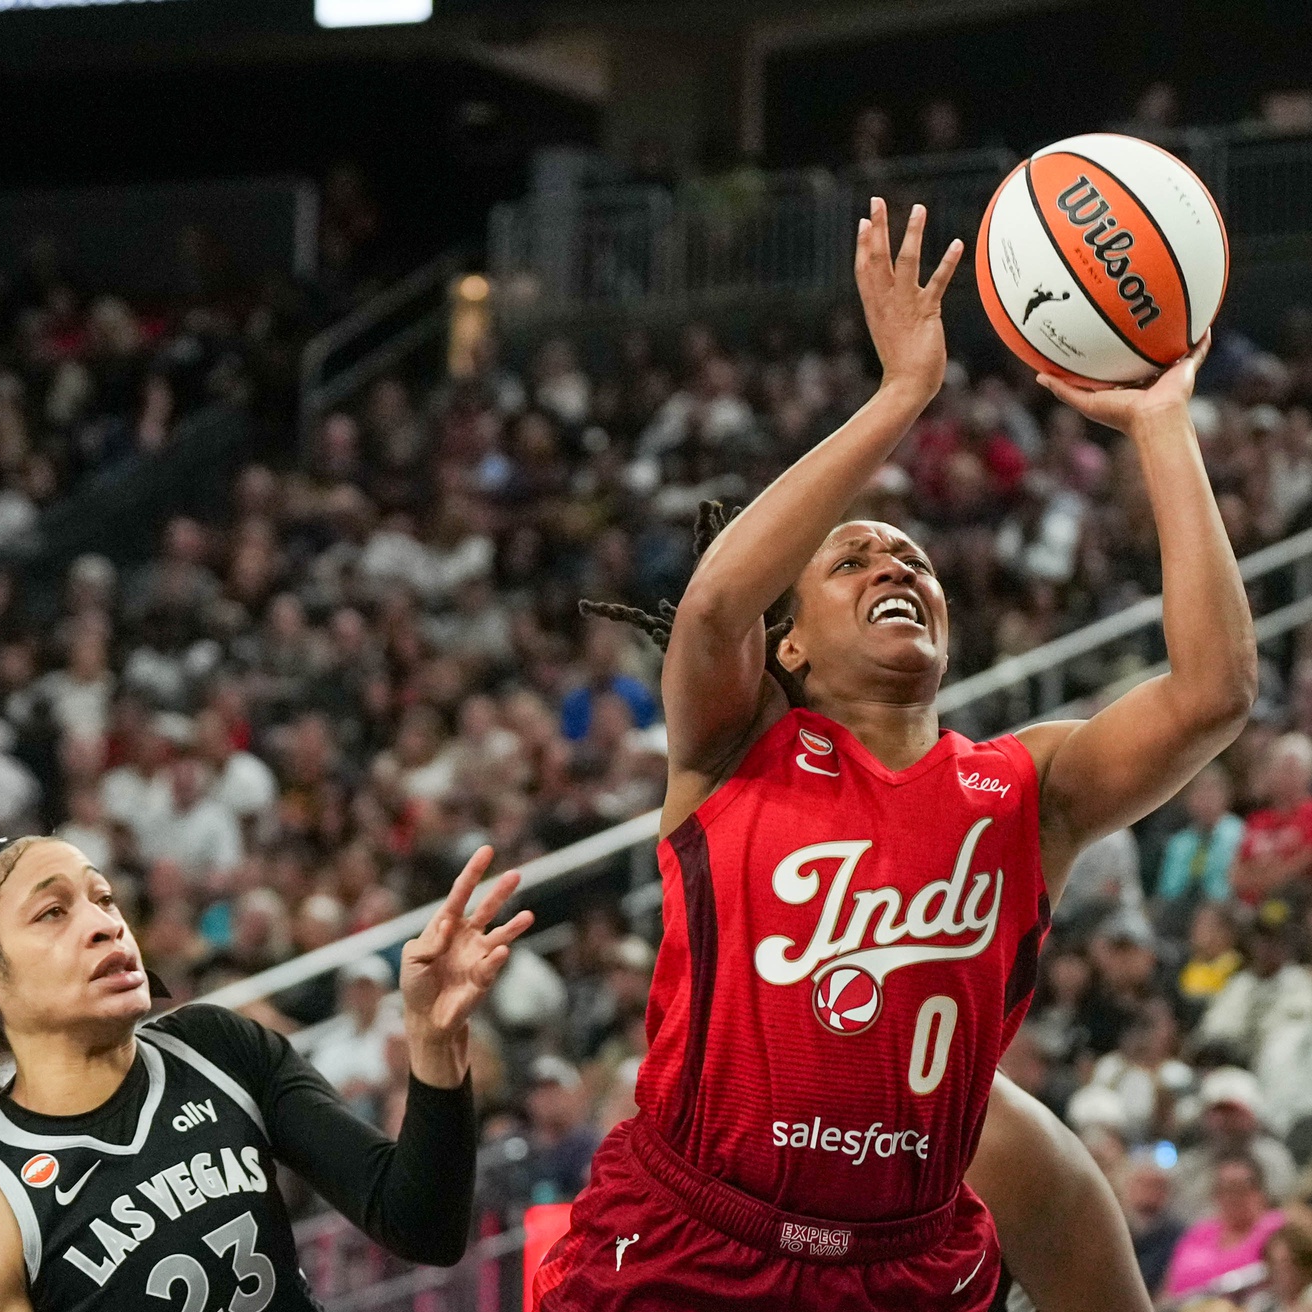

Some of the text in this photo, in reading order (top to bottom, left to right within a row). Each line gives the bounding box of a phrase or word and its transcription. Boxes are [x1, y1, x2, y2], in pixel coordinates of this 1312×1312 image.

[1056, 173, 1162, 332] Wilson
[957, 771, 1012, 799] Lilly
[754, 816, 1003, 986] Indy
[908, 995, 958, 1095] 0
[171, 1098, 219, 1133] ally
[772, 1116, 930, 1166] salesforce
[62, 1145, 270, 1288] LAS VEGAS
[781, 1222, 852, 1247] EXPECT
[780, 1238, 848, 1256] TO WIN
